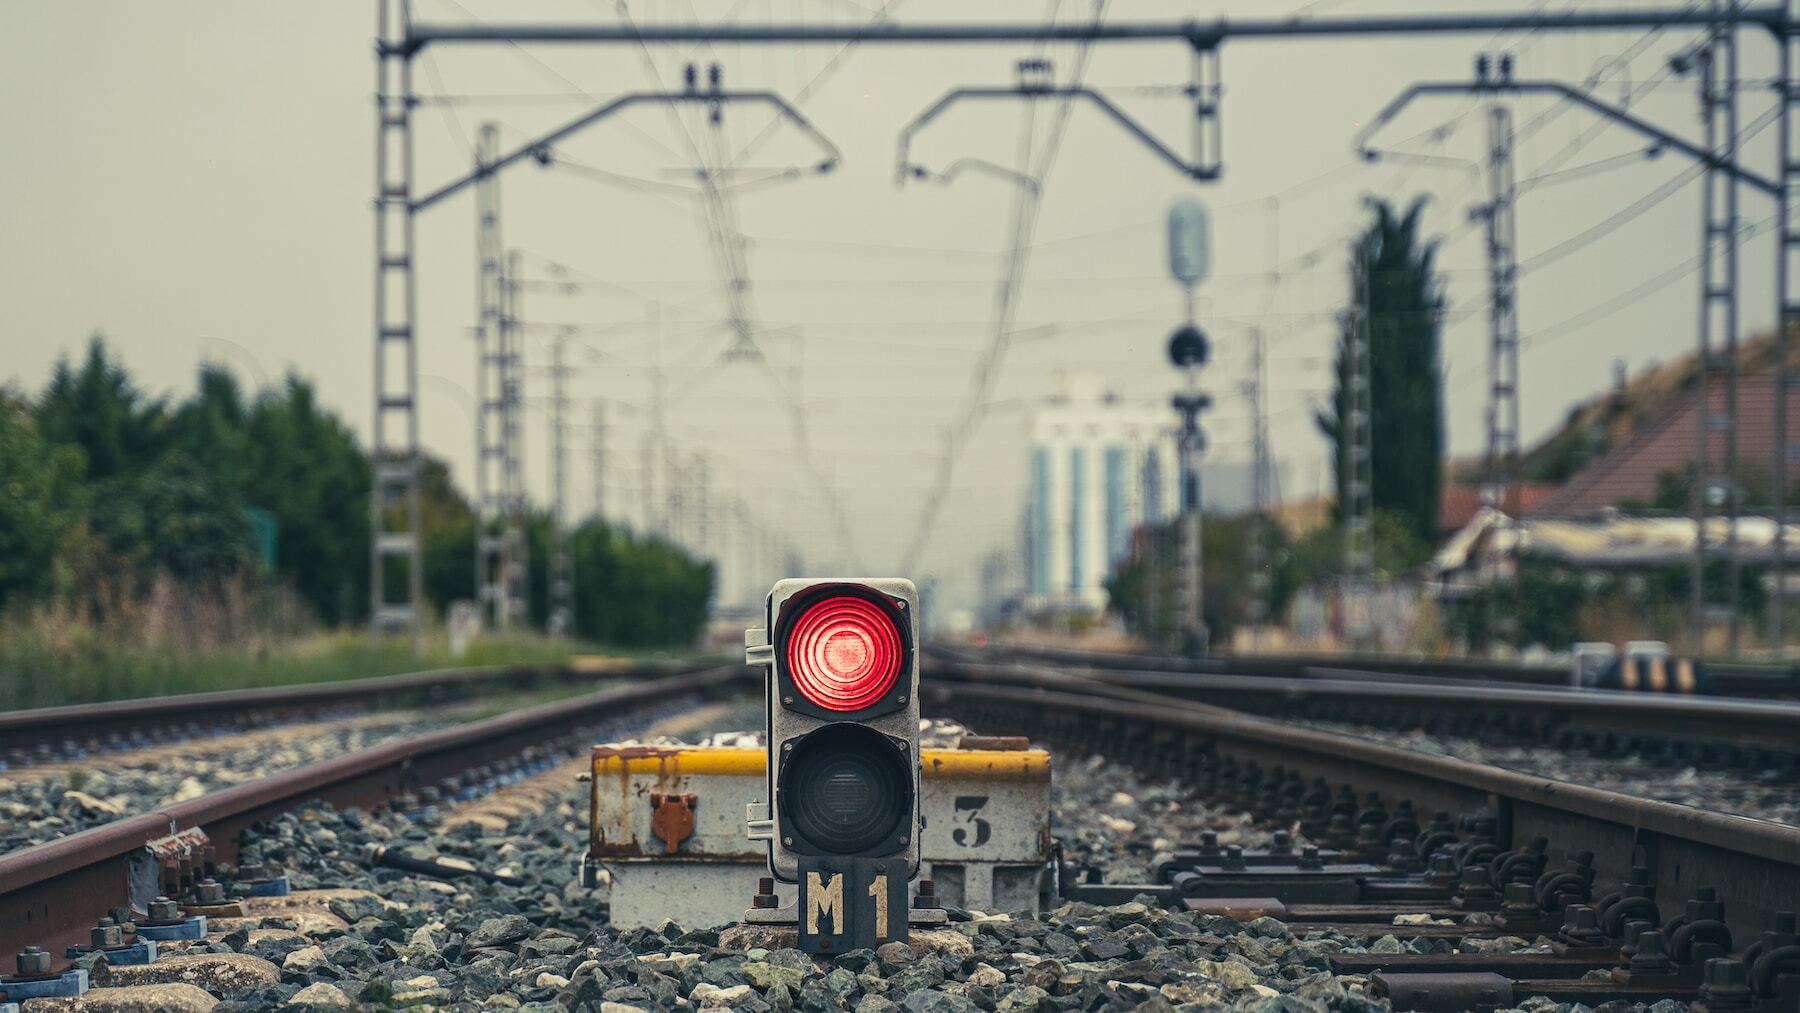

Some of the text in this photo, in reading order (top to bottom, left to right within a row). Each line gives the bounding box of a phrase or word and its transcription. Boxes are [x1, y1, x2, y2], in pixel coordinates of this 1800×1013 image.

[953, 796, 991, 847] 3
[807, 872, 887, 938] M 1
